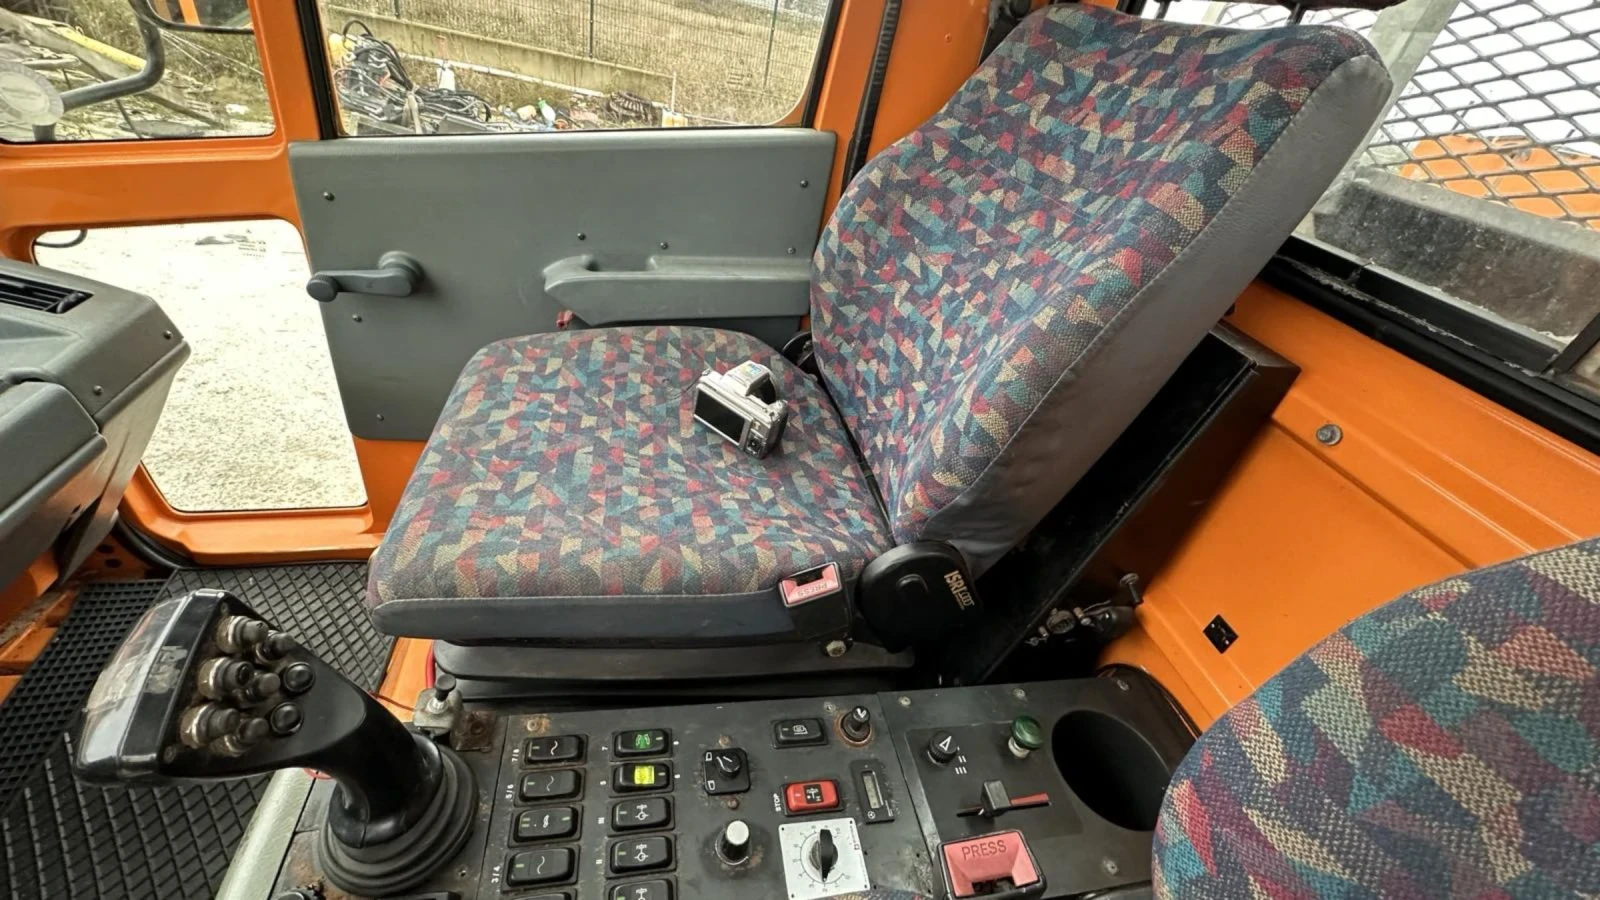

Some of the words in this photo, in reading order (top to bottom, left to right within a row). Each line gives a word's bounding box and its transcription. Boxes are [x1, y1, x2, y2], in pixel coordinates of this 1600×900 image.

[797, 582, 828, 597] PRESS
[944, 570, 965, 595] ISRI
[773, 793, 782, 812] STOP
[961, 839, 1007, 861] PRESS
